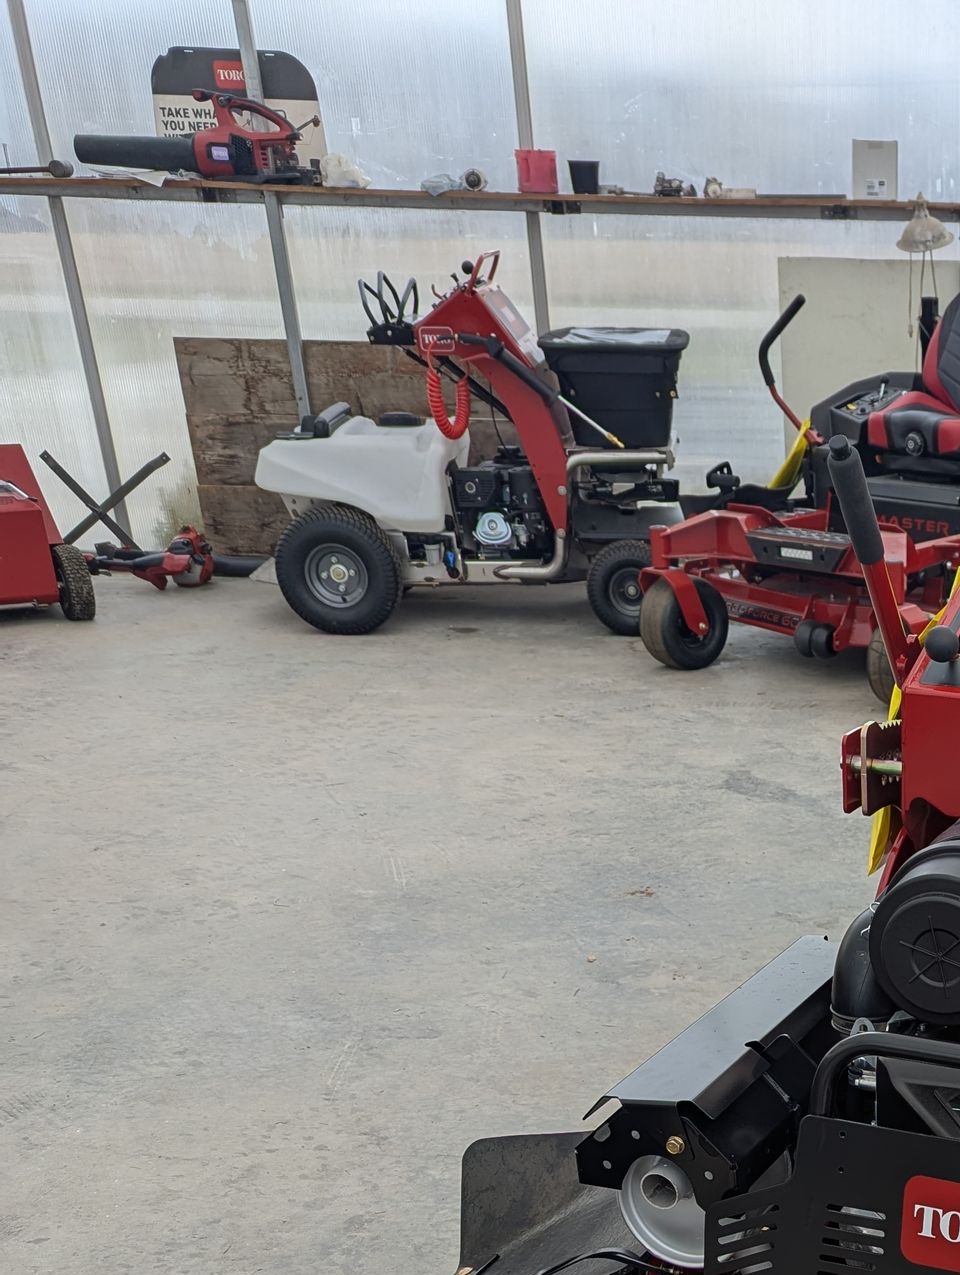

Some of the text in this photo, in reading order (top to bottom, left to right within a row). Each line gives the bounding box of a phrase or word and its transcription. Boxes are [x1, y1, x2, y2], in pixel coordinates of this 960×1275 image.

[159, 106, 217, 119] TAKE WH
[161, 120, 185, 131] YOU
